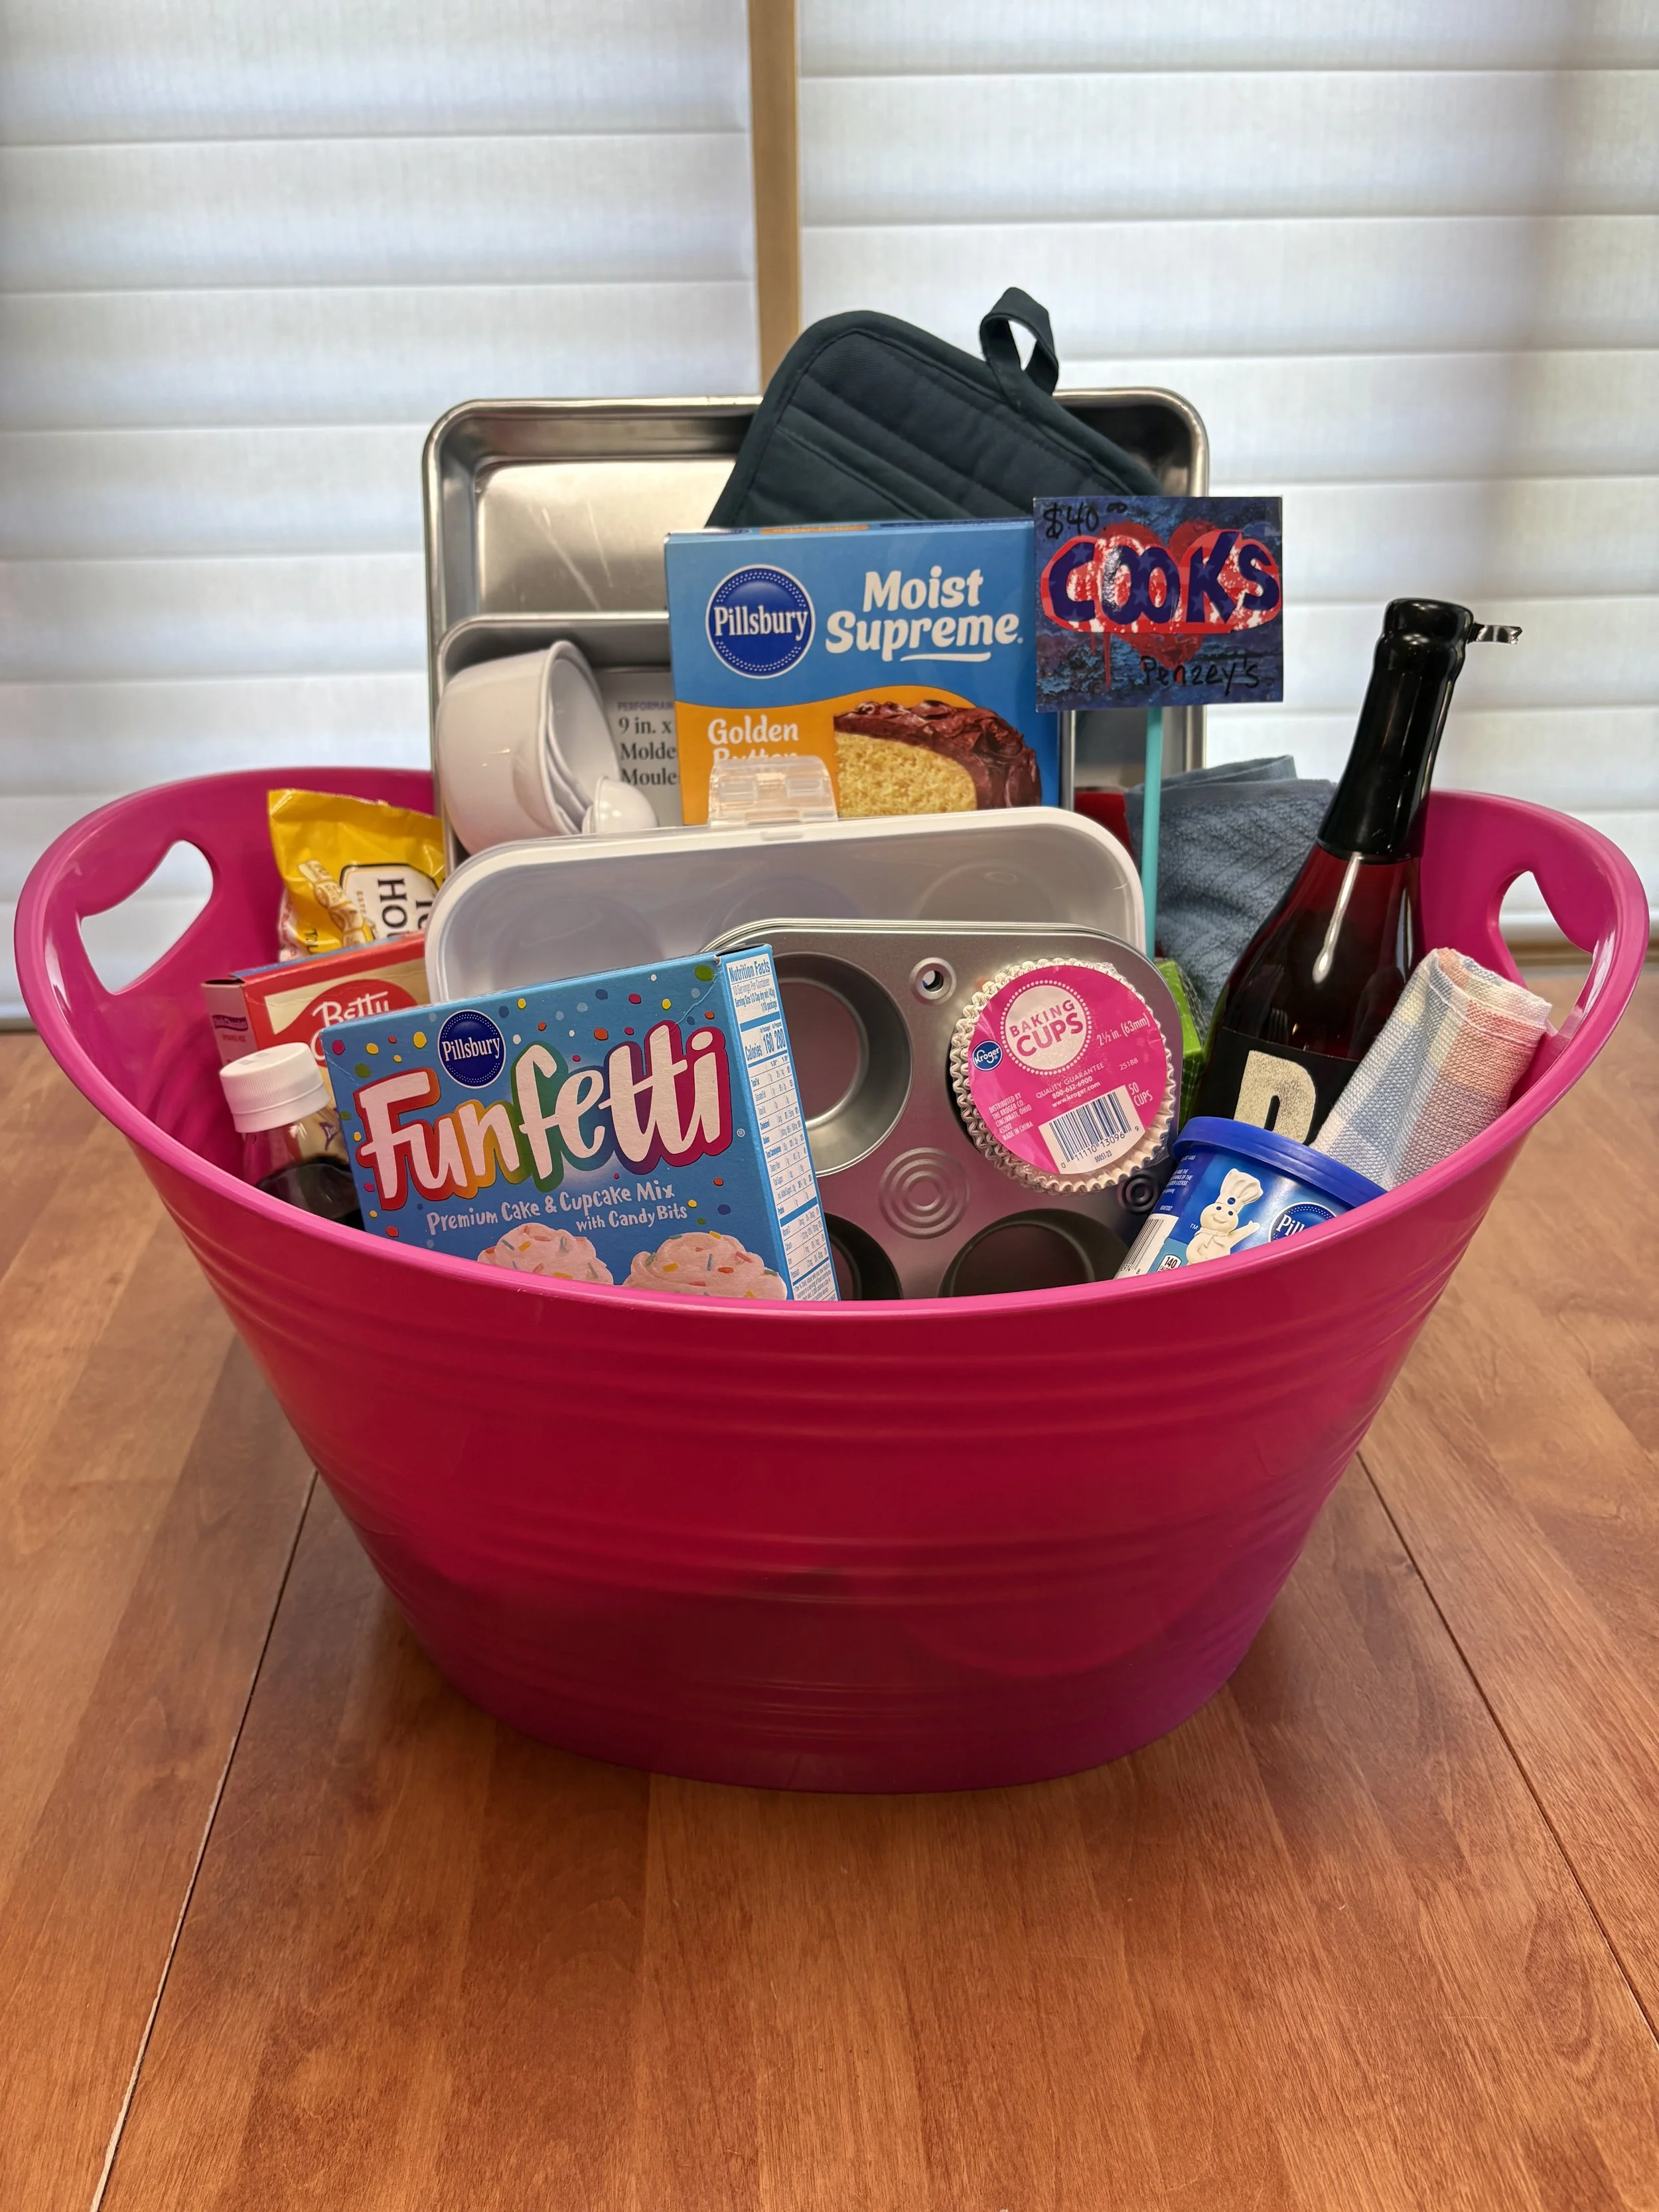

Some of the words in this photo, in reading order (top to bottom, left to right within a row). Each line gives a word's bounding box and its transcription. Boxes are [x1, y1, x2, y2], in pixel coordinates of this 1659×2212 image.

[863, 565, 983, 613] Moist
[1048, 531, 1279, 625] COOKS
[713, 605, 808, 641] Pillsbury
[826, 610, 1019, 662] Supreme
[618, 717, 629, 734] 9
[634, 717, 656, 734] in.
[662, 721, 672, 734] x
[707, 715, 799, 745] Golden
[620, 741, 677, 761] Molde
[621, 767, 678, 786] Moule
[729, 963, 755, 983] Nutrition
[753, 959, 770, 976] Facts
[1009, 999, 1075, 1037] BAKING
[1110, 1029, 1122, 1040] in.
[1120, 1012, 1151, 1037] (63mm)
[745, 1043, 762, 1061] Calories
[763, 1032, 774, 1054] 160
[774, 1028, 786, 1050] 280
[1017, 1012, 1084, 1057] CUPS
[441, 1037, 500, 1061] Pillsbury
[974, 1047, 1000, 1065] Kroger
[1119, 1057, 1139, 1070] 25188
[1036, 1080, 1062, 1099] QUALITY
[1064, 1062, 1104, 1085] GUARANTEE
[1052, 1076, 1093, 1099] 800-632-6900
[1128, 1082, 1139, 1095] 50
[988, 1095, 1015, 1114] DISTRIBUTED
[1014, 1092, 1022, 1100] BY
[1052, 1081, 1101, 1108] www.kroger.com
[1133, 1090, 1153, 1107] CUPS
[354, 1021, 731, 1209] Funfetti
[992, 1111, 1001, 1120] THE
[1000, 1103, 1018, 1117] KROGER
[1019, 1104, 1032, 1114] OHIO
[999, 1124, 1013, 1134] 45202
[1001, 1130, 1015, 1142] MADE
[1019, 1121, 1034, 1134] CHINA
[1074, 1145, 1097, 1161] 11110
[1100, 1132, 1125, 1148] 13096
[427, 1207, 498, 1235] Premium
[501, 1200, 540, 1222] Cake
[544, 1195, 557, 1213] &
[559, 1185, 631, 1217] Cupcake
[636, 1179, 675, 1202] Mix
[576, 1215, 605, 1232] with
[609, 1207, 655, 1228] Candy
[656, 1203, 688, 1221] Bits
[1165, 1256, 1178, 1269] 140
